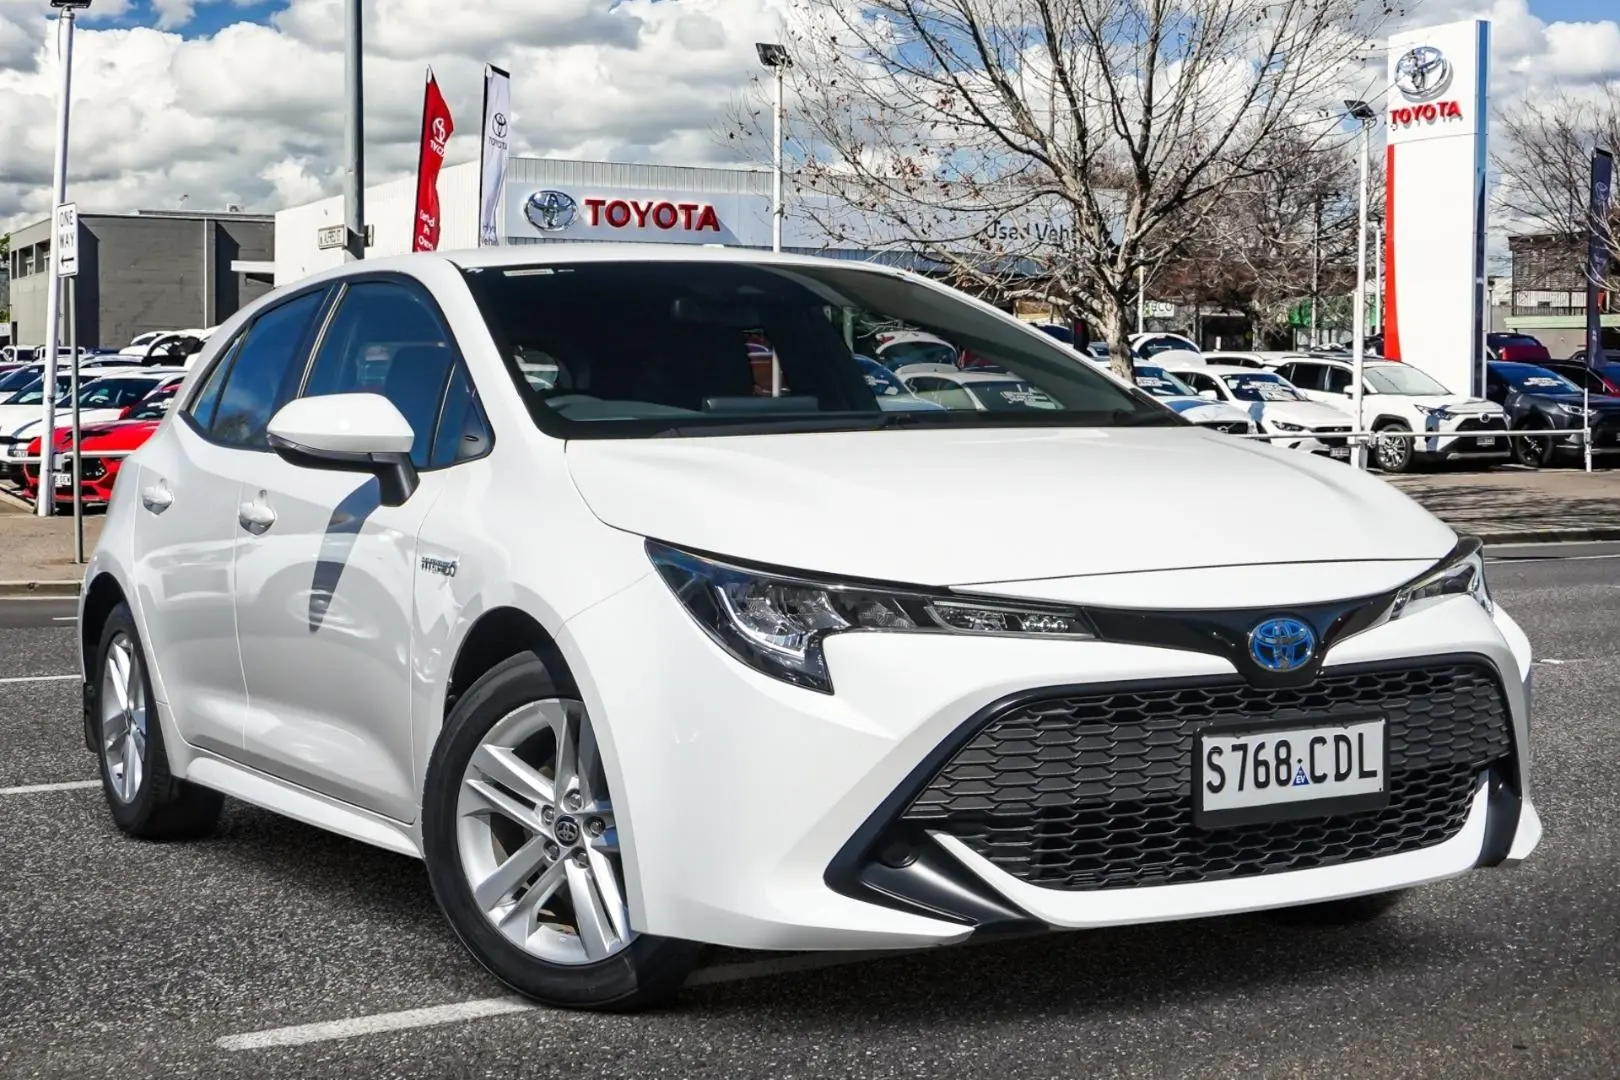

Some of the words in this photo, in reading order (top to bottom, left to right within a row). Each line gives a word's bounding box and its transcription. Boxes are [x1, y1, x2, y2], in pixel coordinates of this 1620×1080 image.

[1390, 101, 1462, 124] TOYOTA
[489, 136, 507, 150] TOYOTA
[60, 210, 74, 227] ONE
[585, 199, 720, 231] TOYOTA
[60, 231, 75, 248] WAY
[985, 221, 1030, 240] Used
[1206, 739, 1292, 794] S768
[1309, 732, 1378, 784] CDL
[1296, 775, 1305, 784] EV
